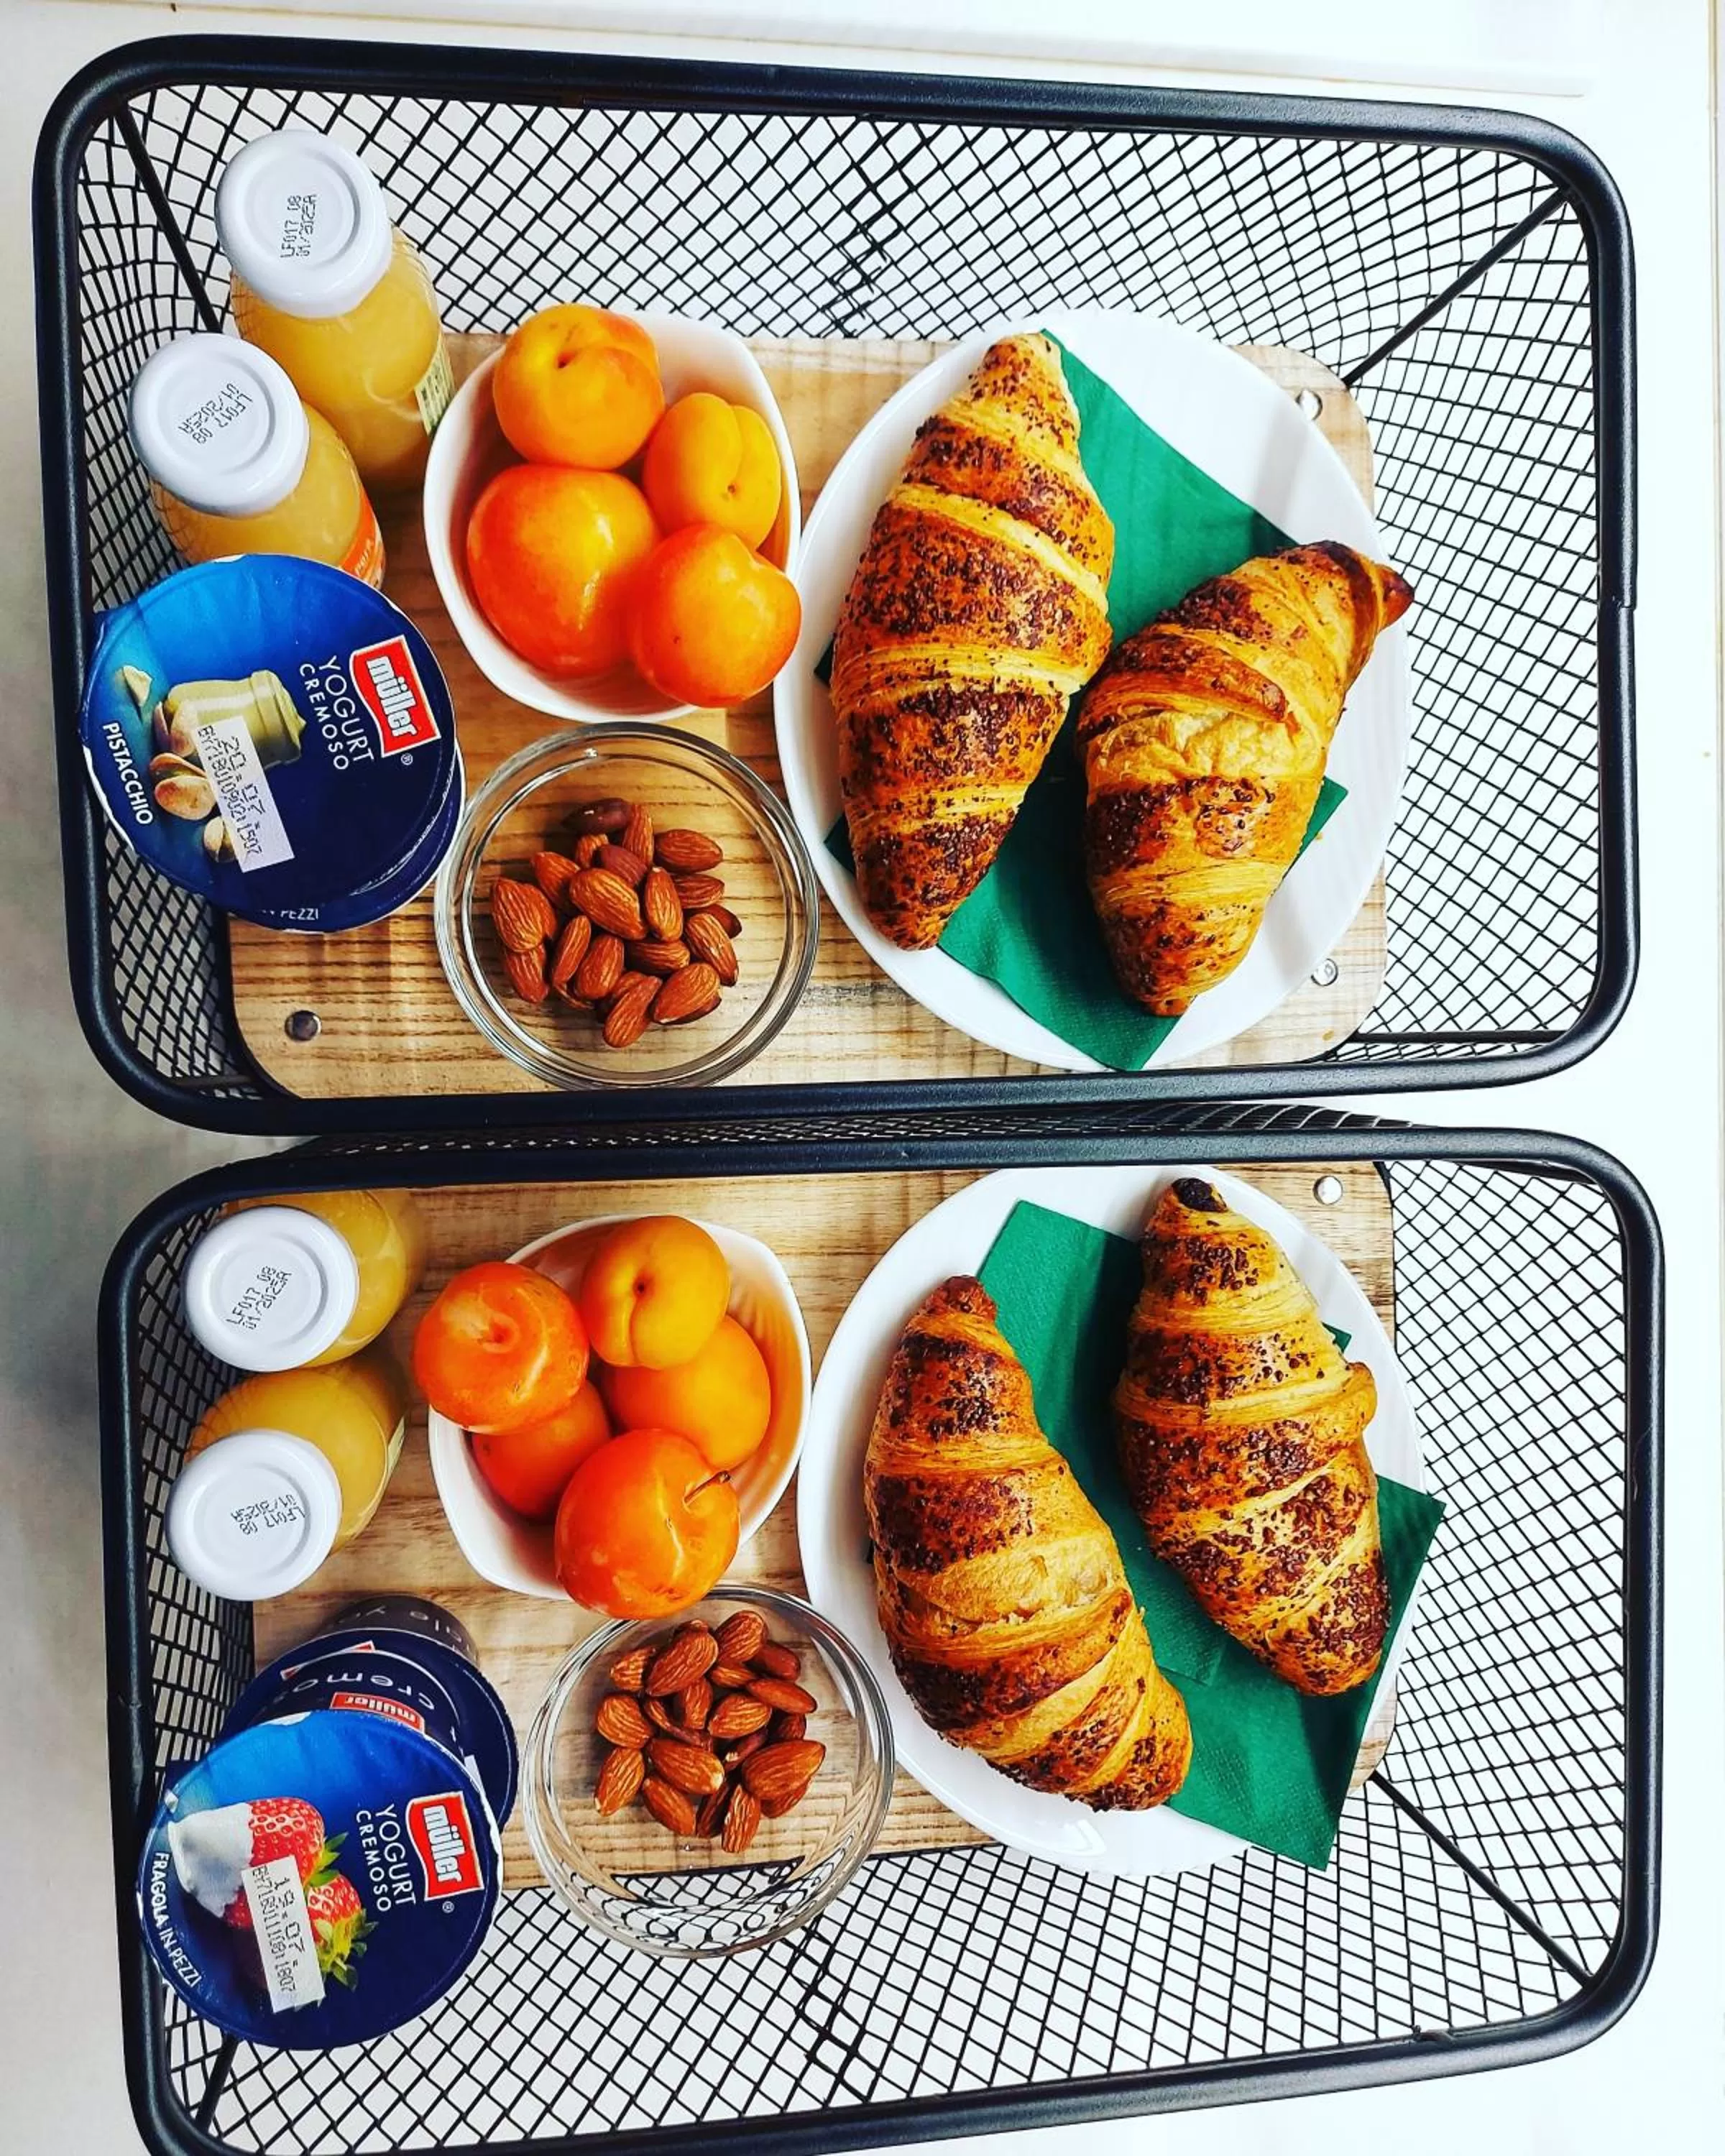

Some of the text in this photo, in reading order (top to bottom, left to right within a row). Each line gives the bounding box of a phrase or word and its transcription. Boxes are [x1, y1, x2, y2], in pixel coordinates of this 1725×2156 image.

[215, 393, 253, 428] LF017
[299, 663, 349, 770] CREMOSO
[318, 655, 374, 762] YOGURT
[366, 655, 418, 737] müller
[103, 722, 153, 824] PISTACCHIO
[264, 1506, 305, 1528] LF017
[356, 1810, 392, 1912] CREMOSO
[374, 1803, 416, 1905] YOGURT
[423, 1805, 466, 1883] müller
[150, 1852, 202, 1988] FRAGOLA IN PEZZI
